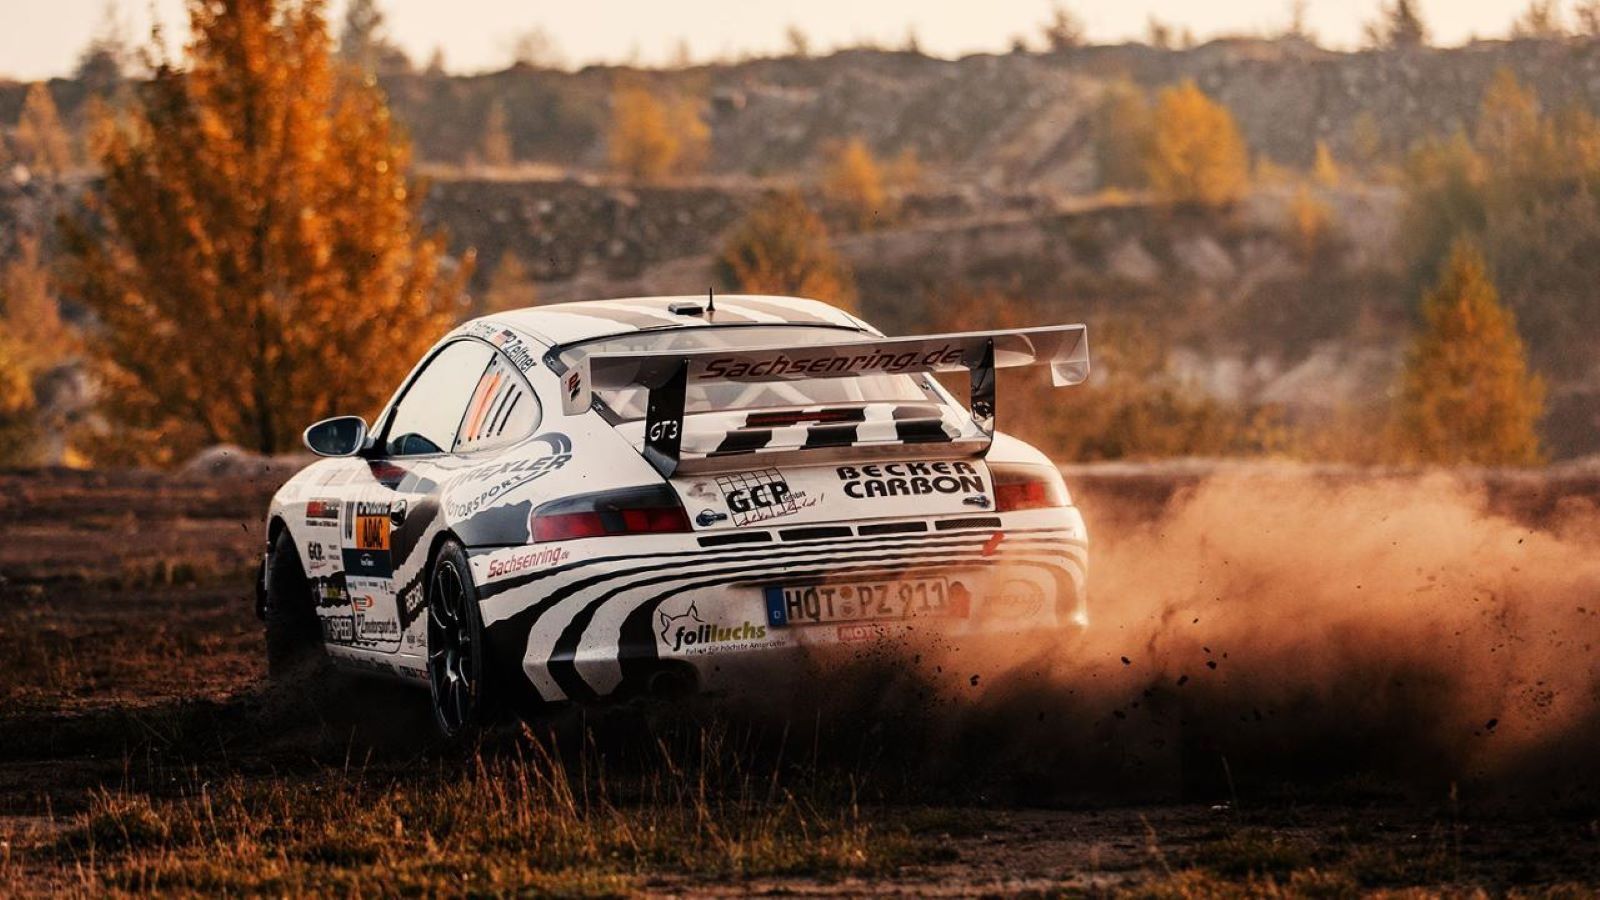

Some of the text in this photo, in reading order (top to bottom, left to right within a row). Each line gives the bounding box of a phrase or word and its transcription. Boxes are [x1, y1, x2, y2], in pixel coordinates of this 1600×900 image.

[699, 345, 964, 379] Sachsenring.de
[650, 420, 678, 441] GT3
[836, 461, 977, 481] BECKER
[725, 480, 790, 513] GCP
[843, 475, 986, 498] CARBON
[859, 584, 892, 616] PZ
[898, 581, 948, 615] 911
[673, 621, 766, 651] foliluchs
